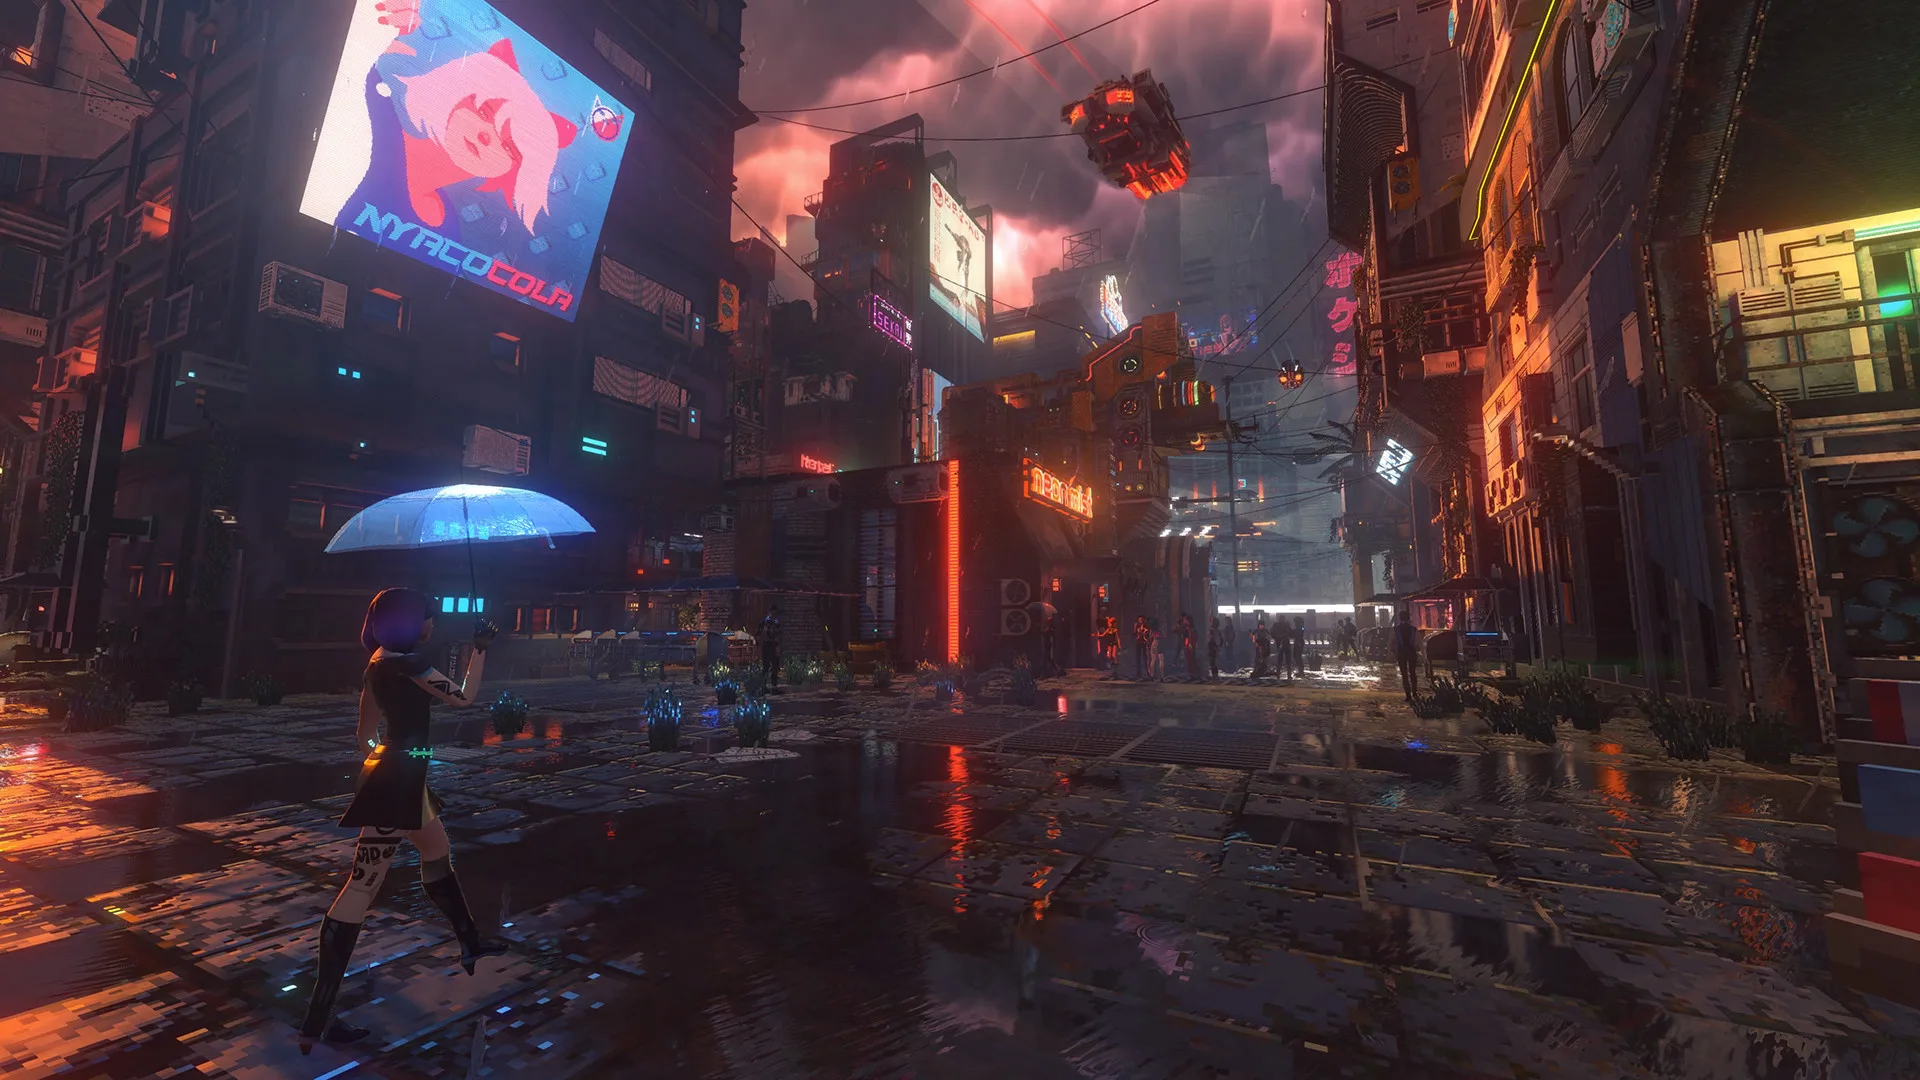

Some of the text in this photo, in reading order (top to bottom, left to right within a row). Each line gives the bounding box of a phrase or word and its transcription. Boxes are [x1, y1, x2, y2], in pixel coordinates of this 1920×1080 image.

[353, 202, 573, 312] NYACOCOLA
[877, 311, 903, 340] SEKAI
[1030, 466, 1069, 507] neon
